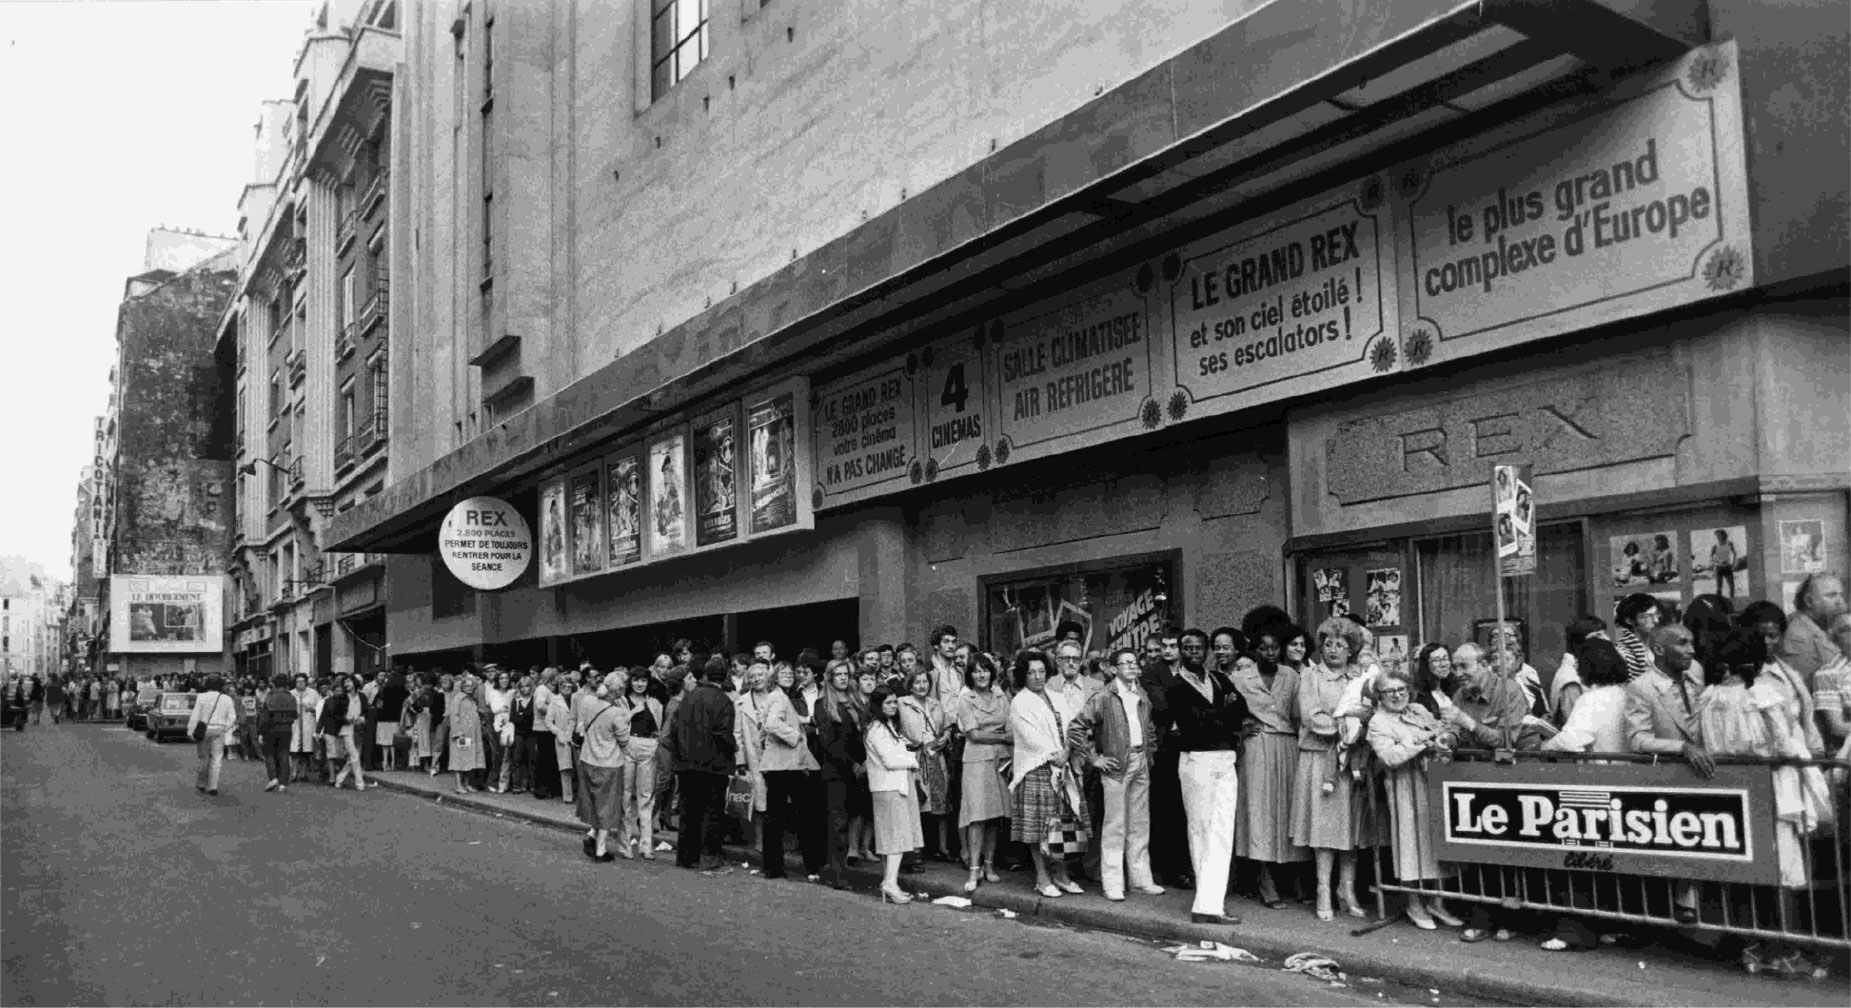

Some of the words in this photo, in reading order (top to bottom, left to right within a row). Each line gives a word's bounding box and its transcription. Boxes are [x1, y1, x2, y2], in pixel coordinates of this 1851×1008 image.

[1448, 204, 1474, 247] le
[1484, 186, 1545, 243] plus
[1555, 138, 1659, 221] grand
[1425, 233, 1556, 298] complexe
[1564, 186, 1711, 257] d'Europe
[1191, 271, 1219, 310] LE
[1226, 242, 1304, 299] GRAND
[1310, 220, 1360, 272] REX
[1190, 321, 1208, 348] et
[1214, 315, 1246, 341] son
[1251, 294, 1284, 331] ciel
[1291, 277, 1349, 318] étoilé
[1004, 342, 1046, 382] SALLE
[1200, 351, 1228, 376] ses
[1234, 319, 1340, 367] escalators
[825, 400, 837, 421] LE
[842, 387, 876, 416] GRAND
[880, 376, 901, 403] REX
[941, 363, 969, 413] 4
[1014, 387, 1041, 421] AIR
[832, 439, 858, 456] votre
[862, 426, 896, 448] cinéma
[862, 407, 896, 434] places
[1398, 399, 1600, 472] REX
[844, 458, 863, 481] PAS
[457, 529, 483, 537] 2.800
[484, 530, 515, 538] PLACES
[466, 510, 508, 527] REX
[444, 539, 476, 548] PERMET
[478, 540, 490, 549] DE
[491, 540, 528, 550] TOUJOURS
[452, 551, 489, 559] RENTRER
[490, 552, 512, 560] POUR
[512, 552, 522, 560] LA
[1109, 587, 1155, 637] VOYAGE
[1453, 792, 1509, 835] Le
[1518, 795, 1740, 849] Parisien
[1564, 851, 1613, 871] libéré
